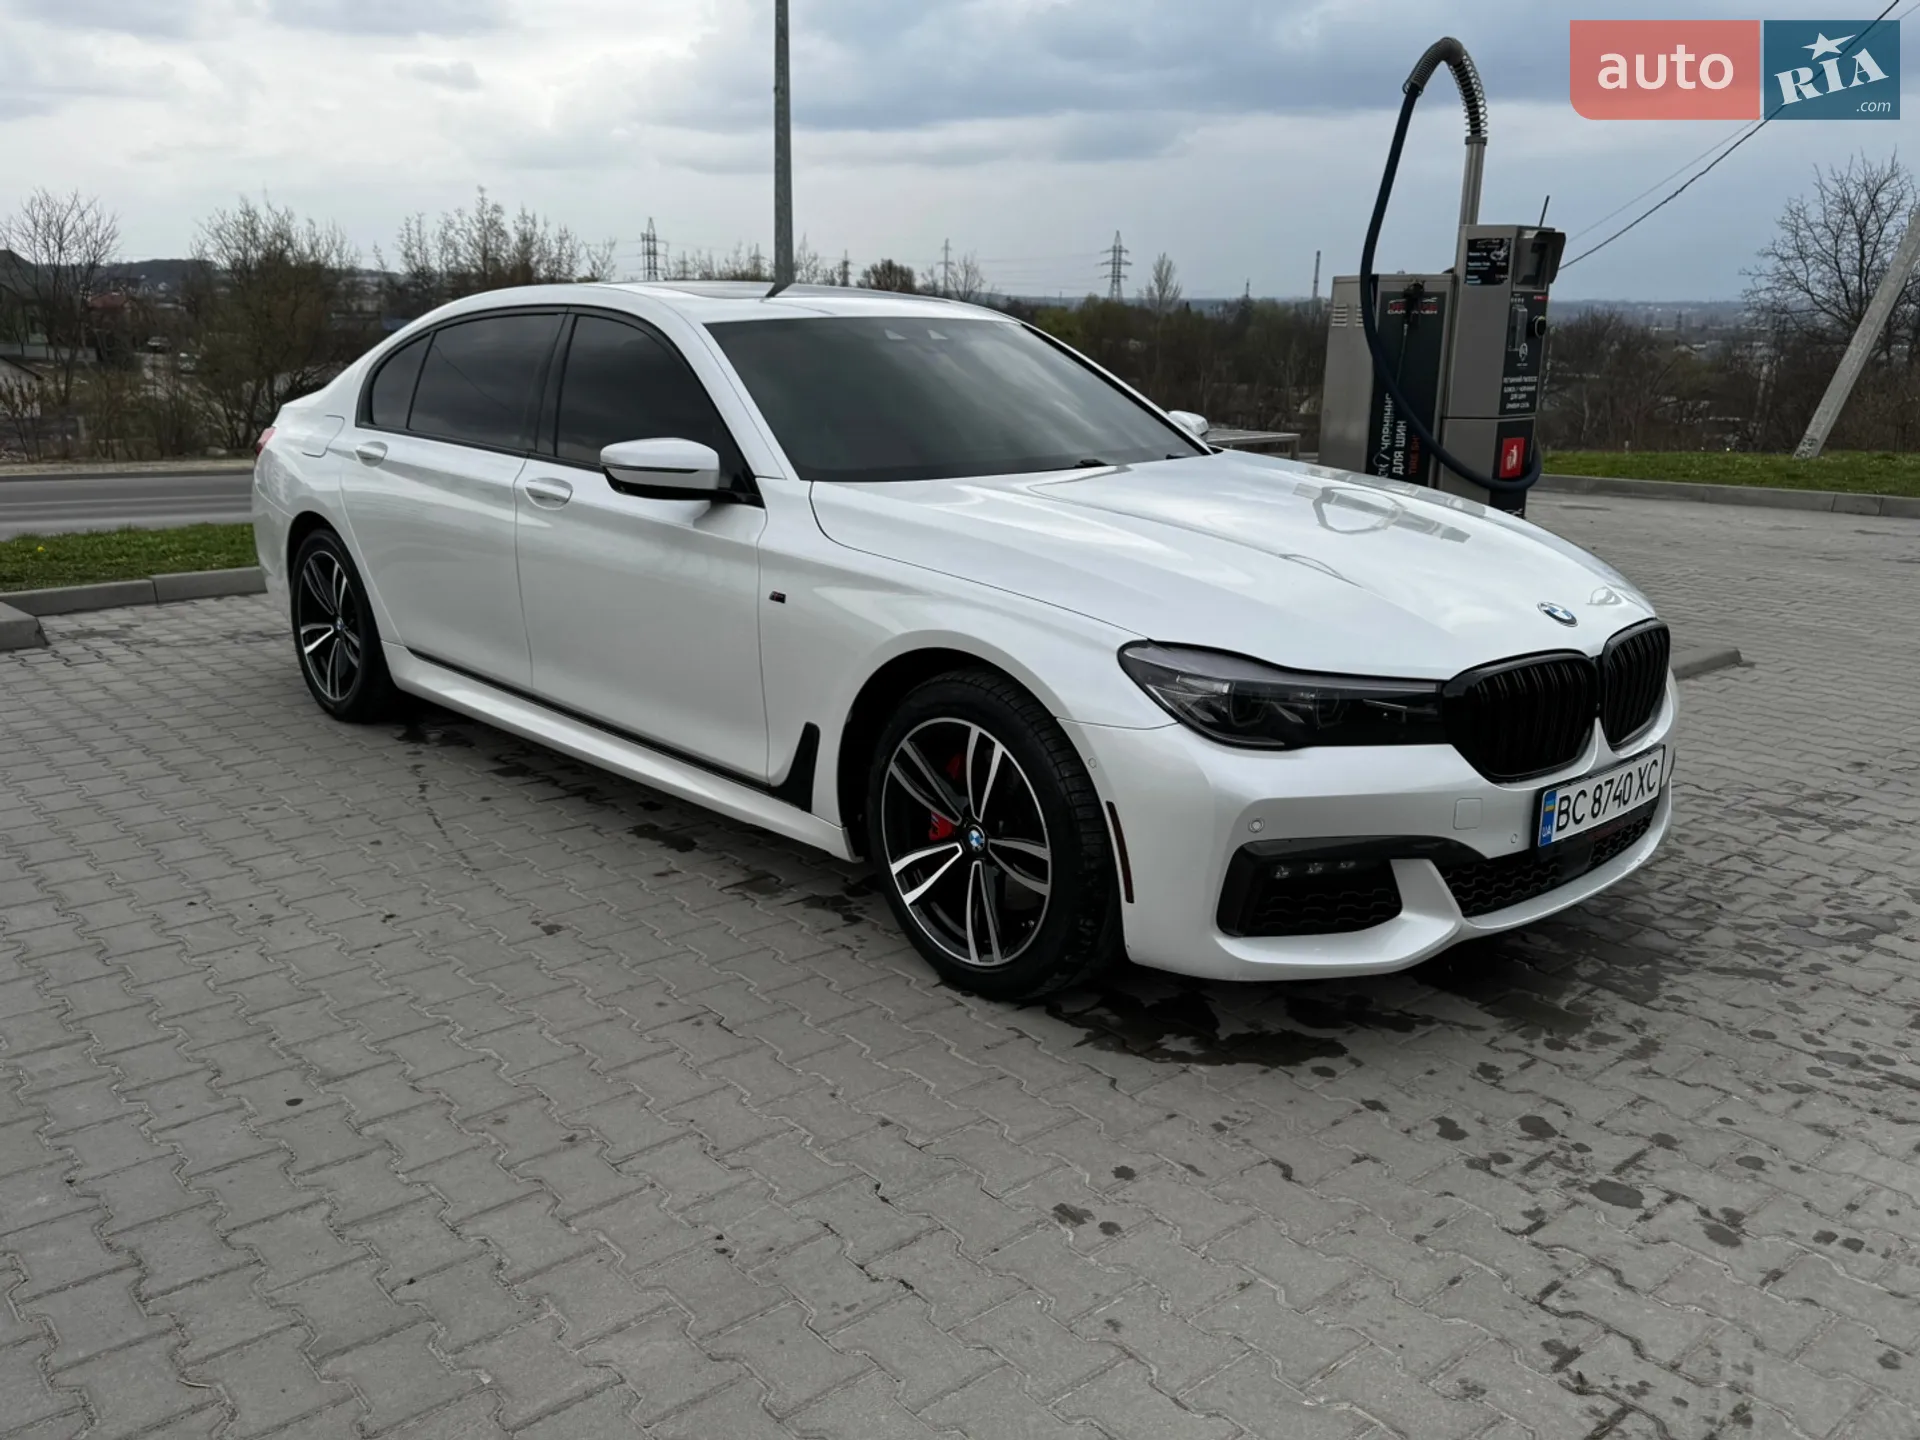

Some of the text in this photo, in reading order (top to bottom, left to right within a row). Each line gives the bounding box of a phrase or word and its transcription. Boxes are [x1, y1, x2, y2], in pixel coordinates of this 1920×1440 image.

[1392, 420, 1407, 475] ДЛЯ ШИН
[1556, 759, 1658, 832] BC 8740 XC
